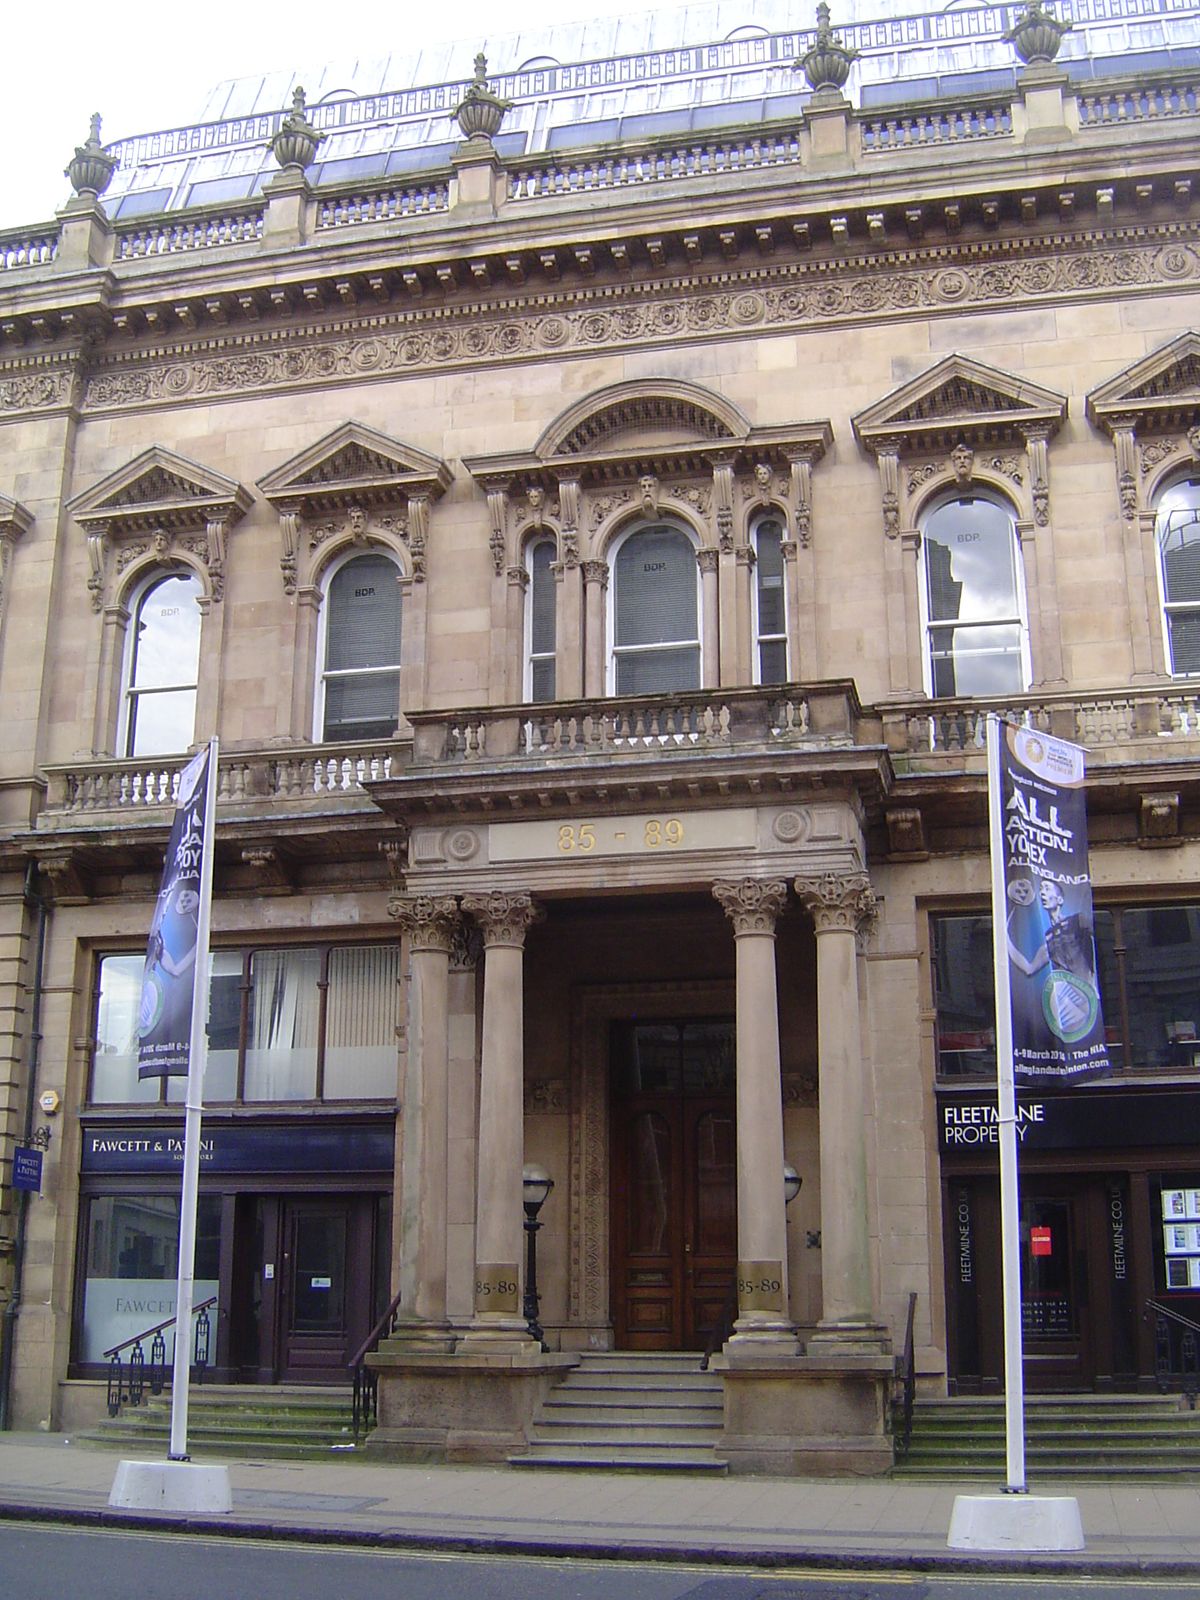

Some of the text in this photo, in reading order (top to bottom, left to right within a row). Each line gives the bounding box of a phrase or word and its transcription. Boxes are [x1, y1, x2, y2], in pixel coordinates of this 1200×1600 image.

[557, 824, 596, 852] 85
[644, 819, 685, 849] 89
[1072, 1050, 1089, 1060] The
[1090, 1043, 1106, 1055] NIA
[944, 1104, 1044, 1124] FLEETMNE
[945, 1125, 1028, 1144] PROPEY
[92, 1138, 214, 1152] FAWCETT & PANI
[475, 1280, 517, 1296] 85-89
[738, 1278, 781, 1295] 85-89
[115, 1298, 178, 1313] FAWCET
